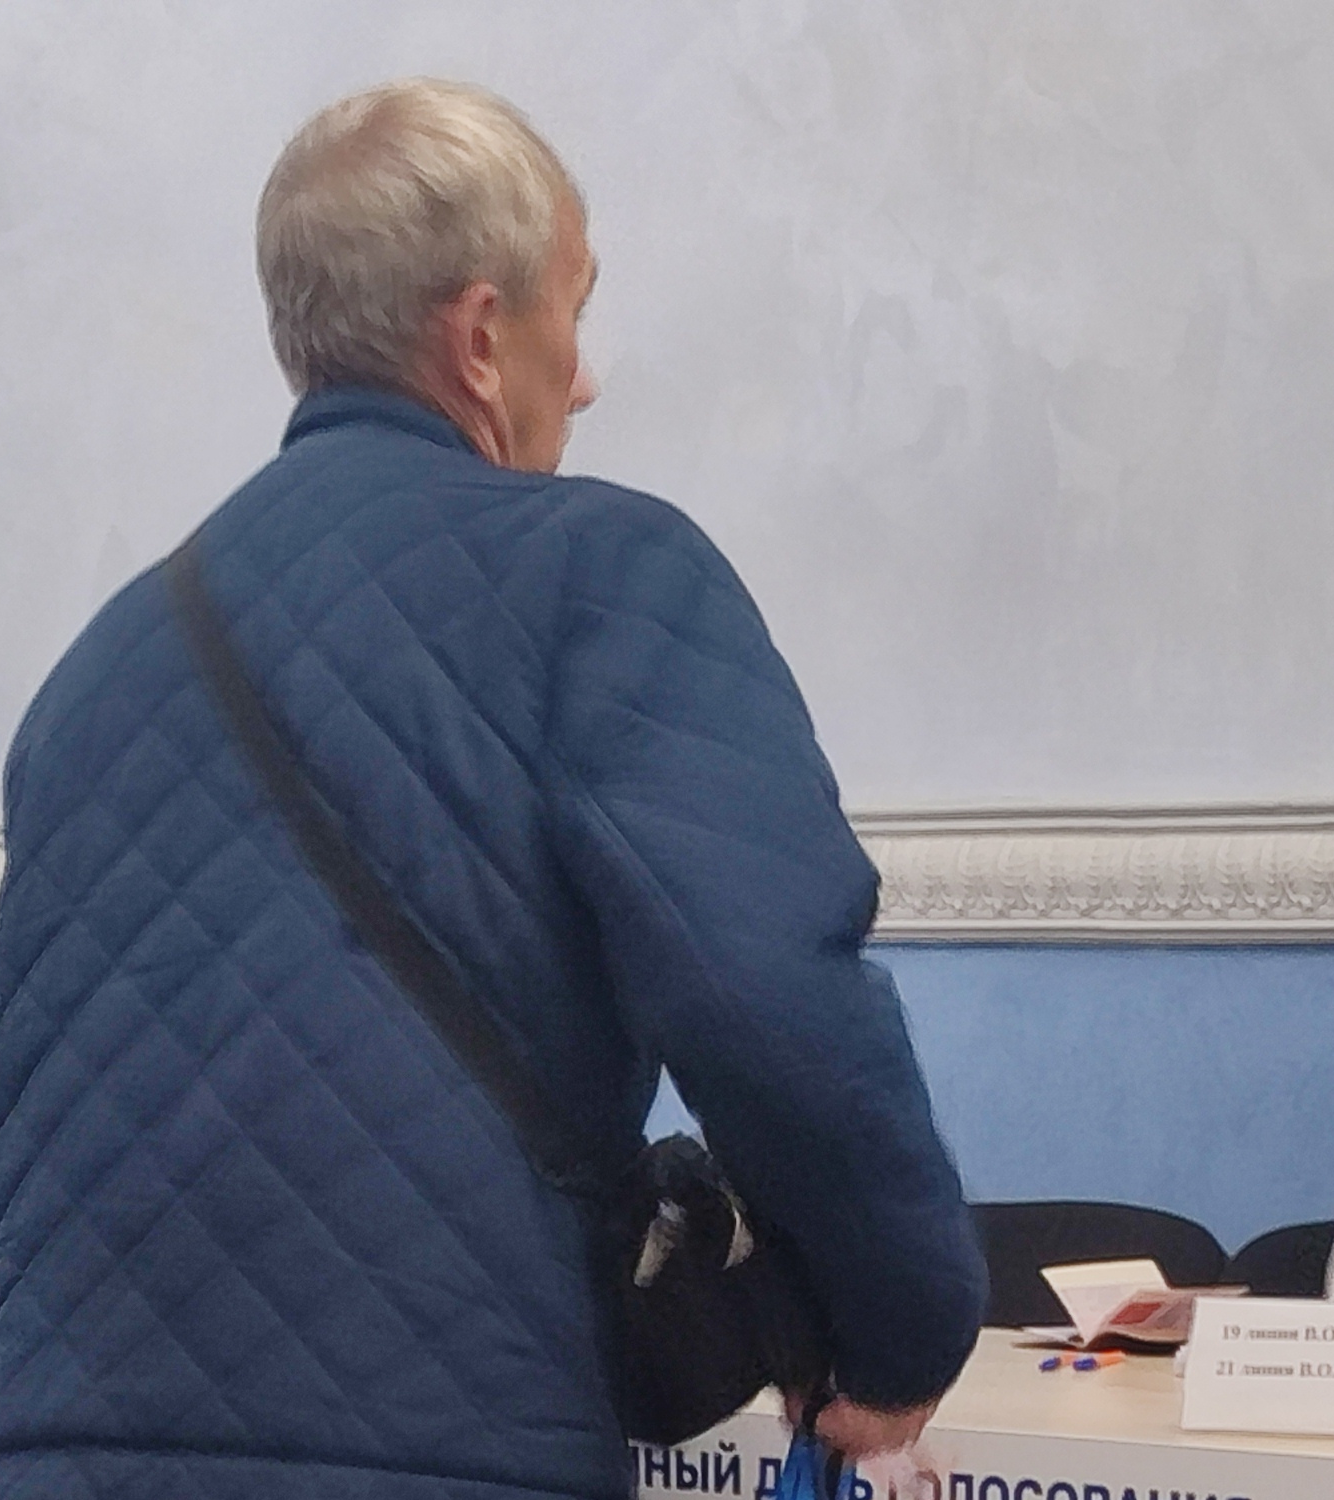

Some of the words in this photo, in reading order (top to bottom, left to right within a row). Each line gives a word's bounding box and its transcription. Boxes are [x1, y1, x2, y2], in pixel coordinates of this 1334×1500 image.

[1222, 1324, 1241, 1340] 19
[1215, 1360, 1234, 1376] 21
[633, 1440, 741, 1497] НЫЙ
